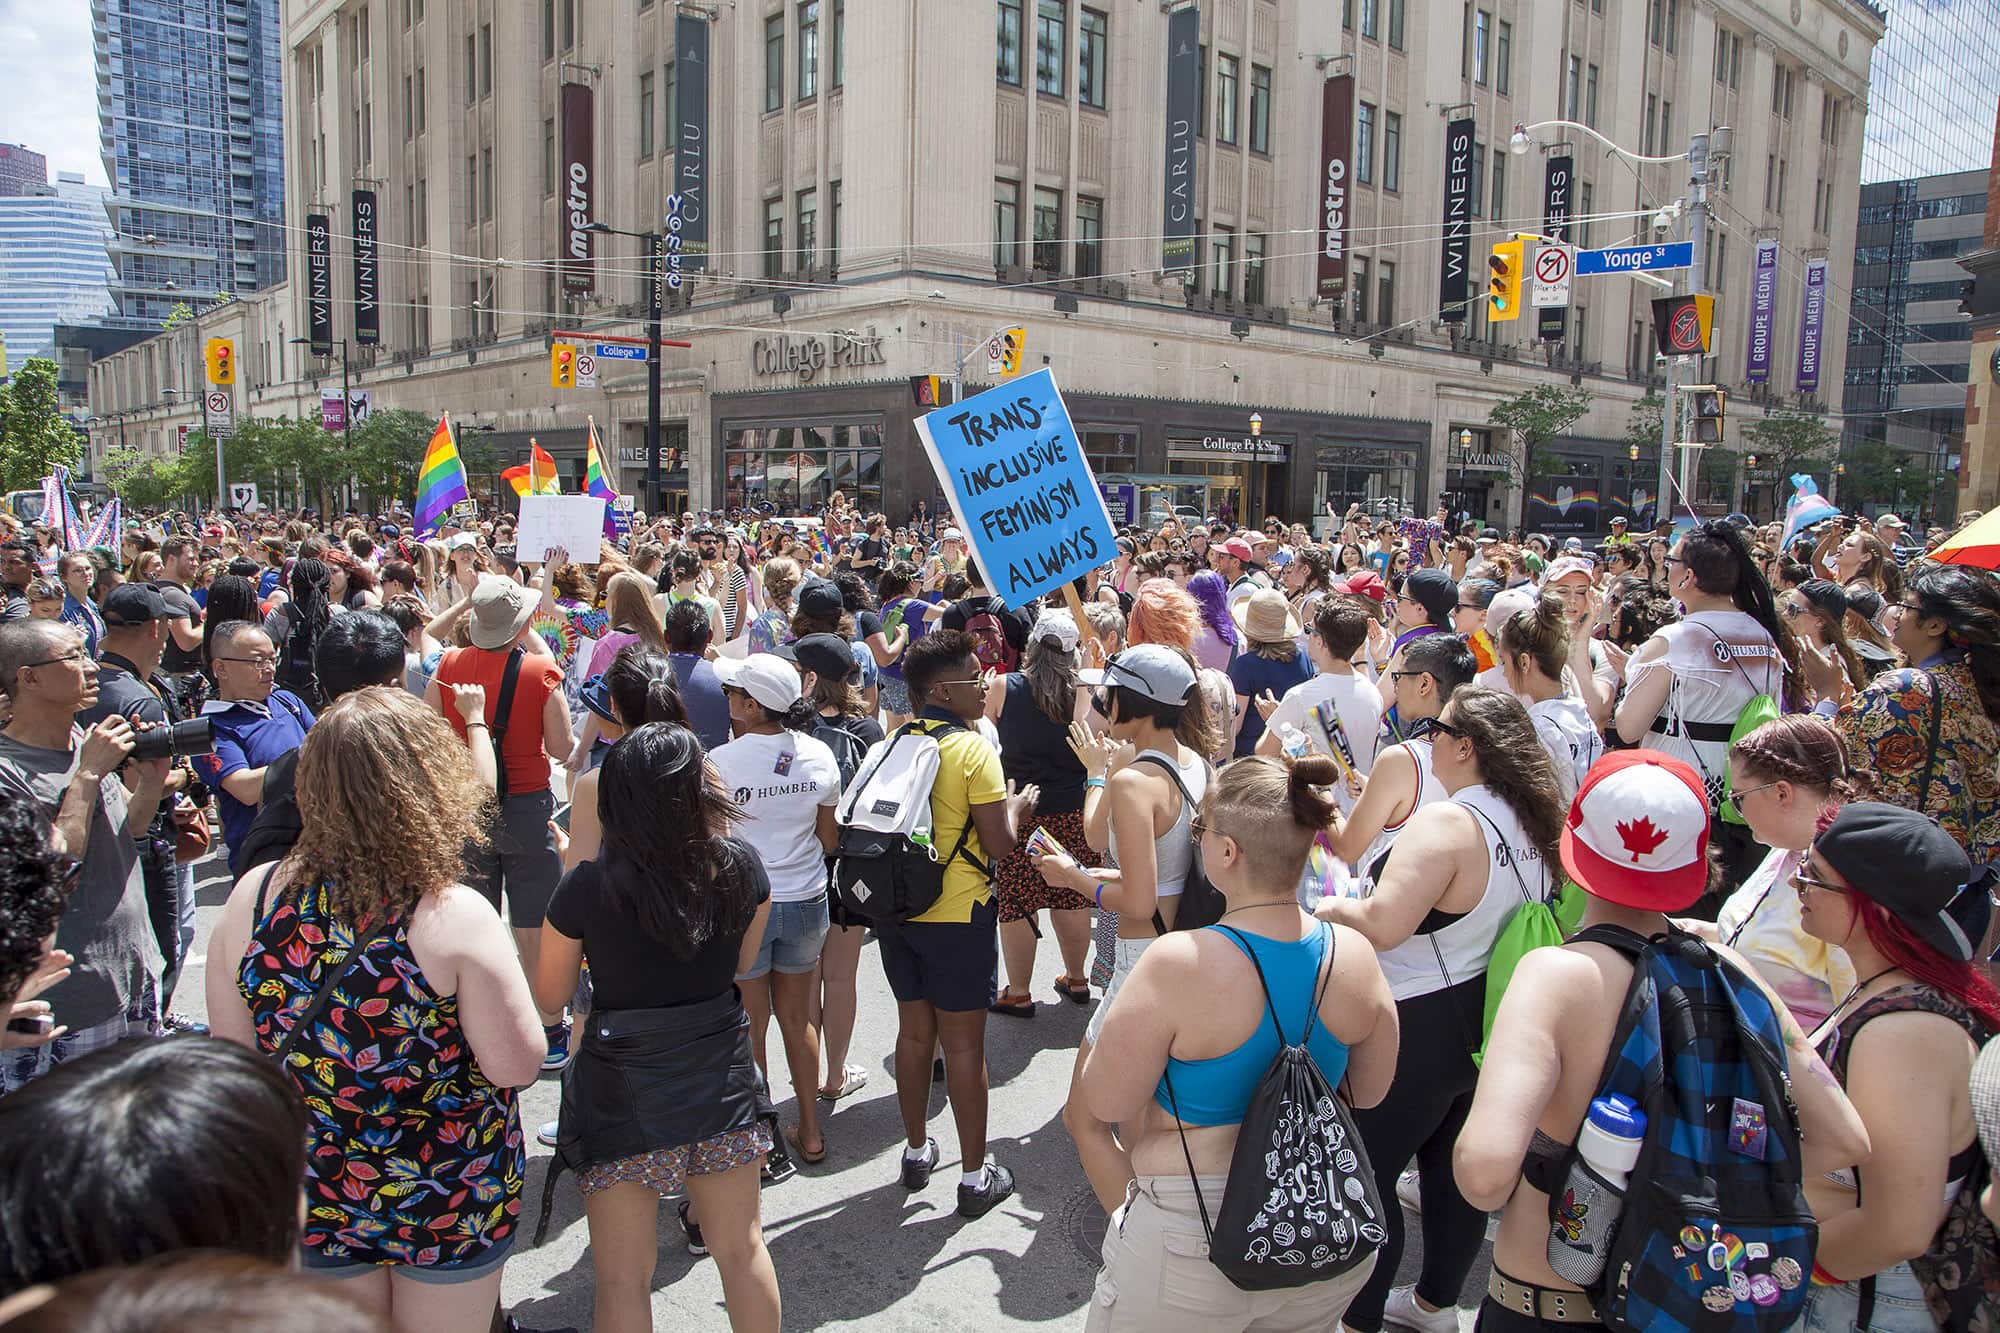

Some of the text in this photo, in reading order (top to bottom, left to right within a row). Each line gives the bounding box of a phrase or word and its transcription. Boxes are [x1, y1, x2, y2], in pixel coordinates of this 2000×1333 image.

[682, 122, 701, 223] CARLU
[1170, 119, 1189, 222] CARLU
[566, 162, 589, 261] metro
[1325, 158, 1346, 260] metro
[1447, 134, 1469, 279] WINNERS
[312, 225, 328, 326] WINNERS
[357, 201, 374, 312] WINNERS
[655, 240, 663, 309] DOWNTOWN
[1603, 247, 1665, 270] Yonge St
[1755, 271, 1772, 310] MÉDIA
[1805, 289, 1820, 325] MÉDIA
[602, 345, 634, 359] College
[751, 325, 887, 383] College Park
[1753, 314, 1769, 362] GROUPE
[1803, 328, 1817, 373] GROUPE
[322, 414, 341, 423] THE
[1203, 436, 1242, 453] College
[1244, 438, 1263, 450] Pak
[1008, 526, 1098, 593] ALWAYS
[758, 781, 818, 798] HUMBER
